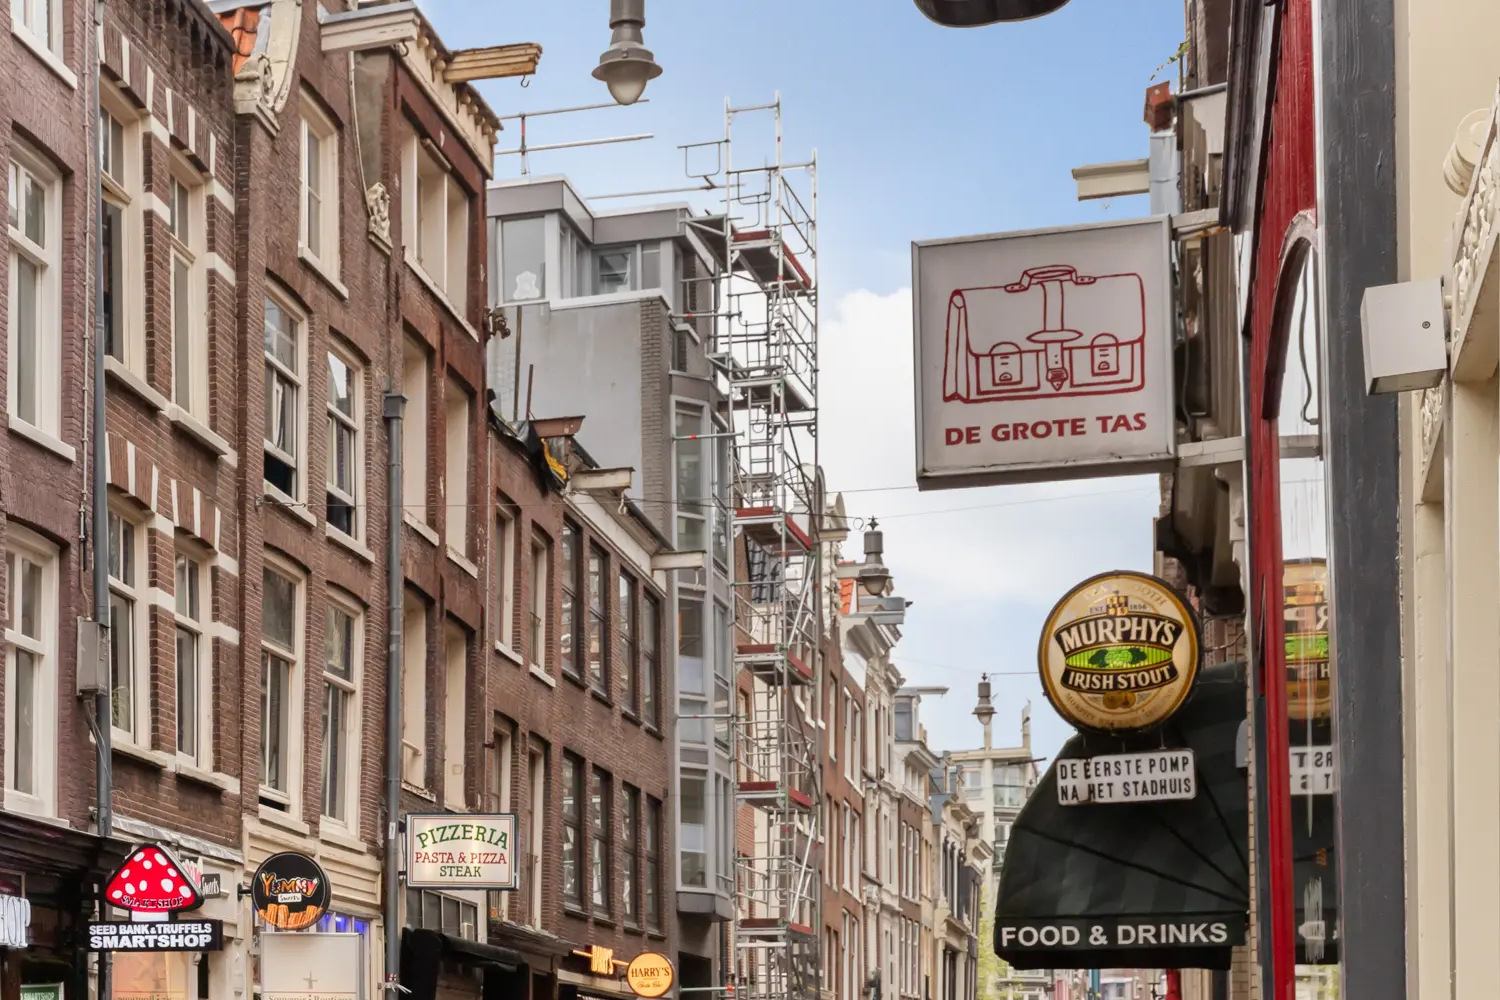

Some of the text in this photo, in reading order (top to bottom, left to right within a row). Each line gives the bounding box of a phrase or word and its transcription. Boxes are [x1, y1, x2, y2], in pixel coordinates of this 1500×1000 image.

[945, 412, 1147, 446] DE GROTE TAS
[1060, 616, 1176, 653] MURPHY'S
[1068, 666, 1171, 690] IRISH STOUT
[1060, 756, 1189, 780] DE EERSTE POMP
[1060, 778, 1191, 801] NA HET STADHUIS
[416, 824, 508, 850] PIZZERIA
[415, 852, 507, 864] PASTA & PIZZA
[440, 865, 481, 877] STEAK
[89, 924, 117, 935] SEED
[119, 924, 150, 935] BANK
[156, 923, 212, 934] TRUFFELS
[1001, 922, 1228, 947] FOOD & DRINKS
[90, 934, 212, 948] SMARTSHOP
[631, 967, 670, 978] HARRY'S
